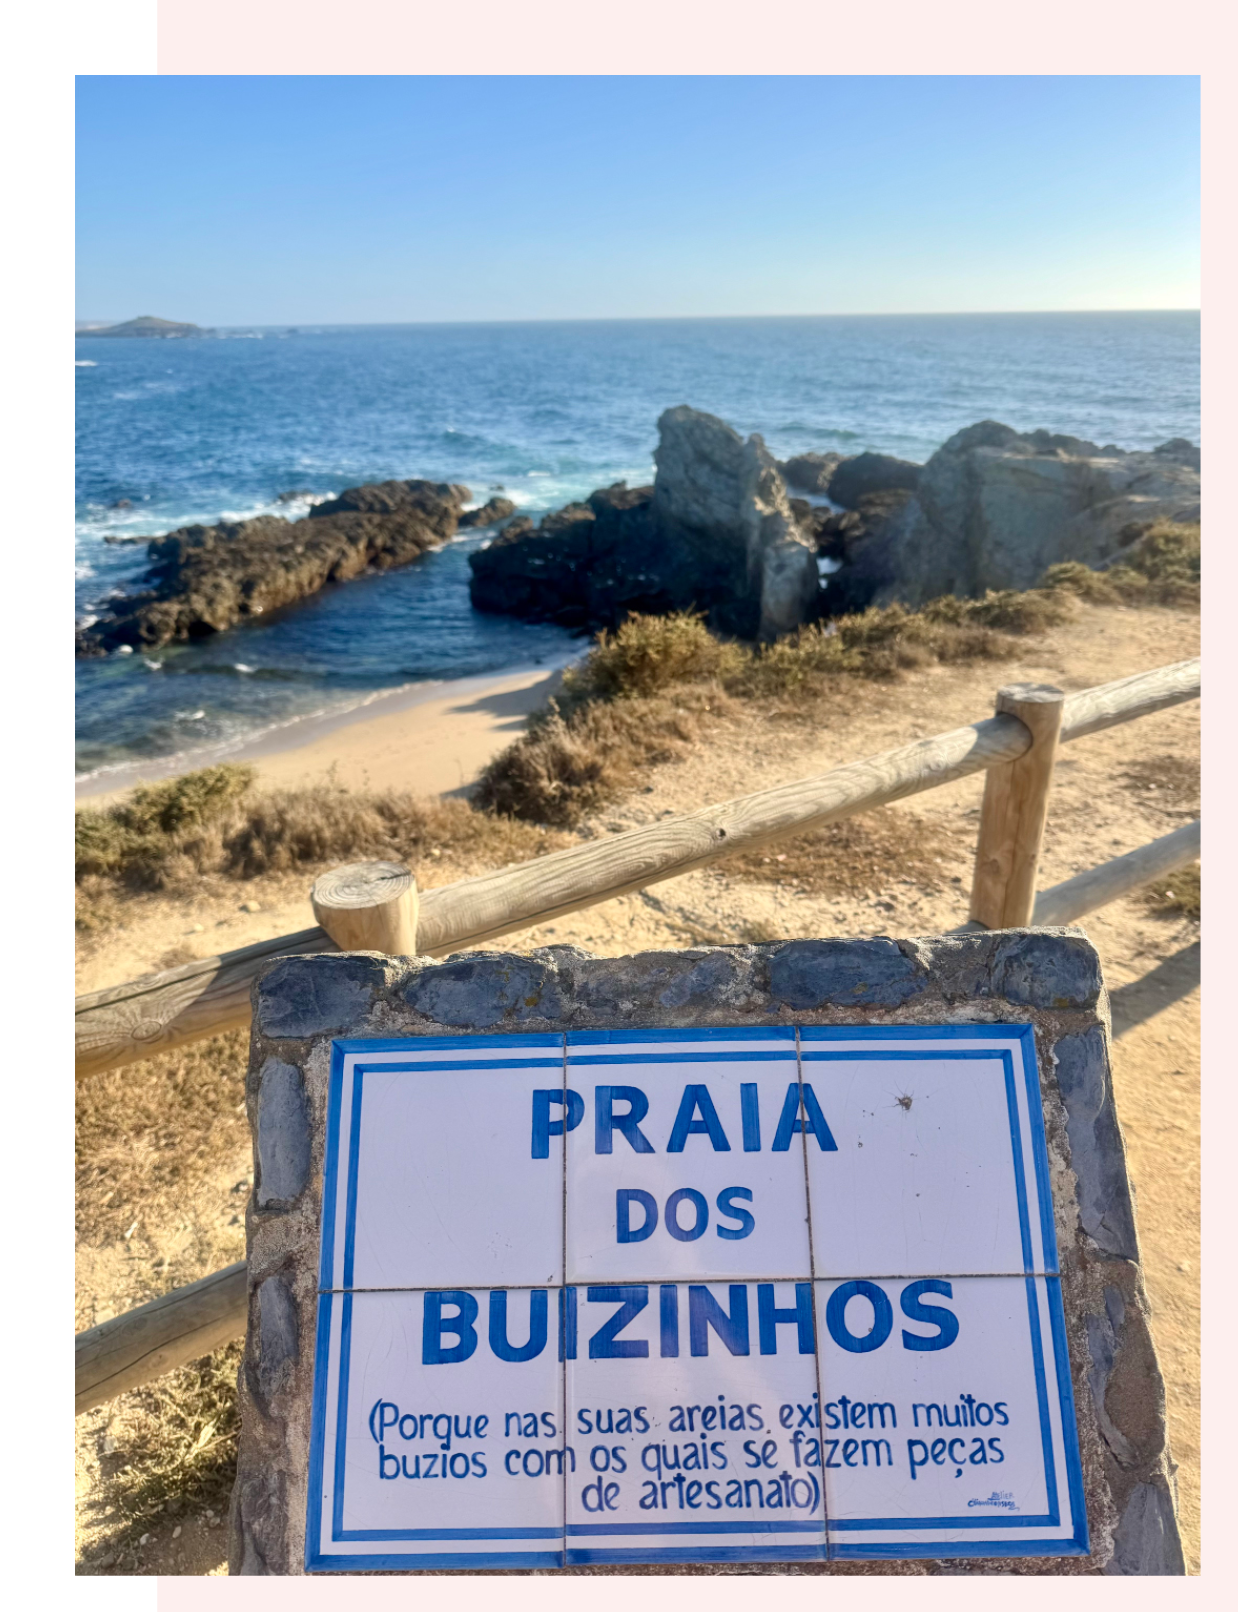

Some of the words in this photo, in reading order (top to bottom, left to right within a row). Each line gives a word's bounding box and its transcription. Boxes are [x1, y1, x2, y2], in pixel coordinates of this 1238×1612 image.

[531, 1082, 838, 1159] PRAIA
[616, 1186, 756, 1244] DOS
[422, 1280, 960, 1365] BUIZINHOS
[505, 1411, 557, 1438] nas
[577, 1406, 650, 1434] suas
[668, 1394, 764, 1432] areias
[779, 1392, 897, 1430] existem
[912, 1393, 1009, 1427] muitos
[378, 1443, 488, 1480] buzios
[504, 1446, 576, 1477] com
[590, 1445, 627, 1473] os
[641, 1433, 728, 1480] quais
[743, 1439, 778, 1468] se
[790, 1430, 893, 1468] fazem
[907, 1436, 1005, 1480] peças
[581, 1475, 620, 1512] de
[639, 1470, 820, 1515] artesanato)
